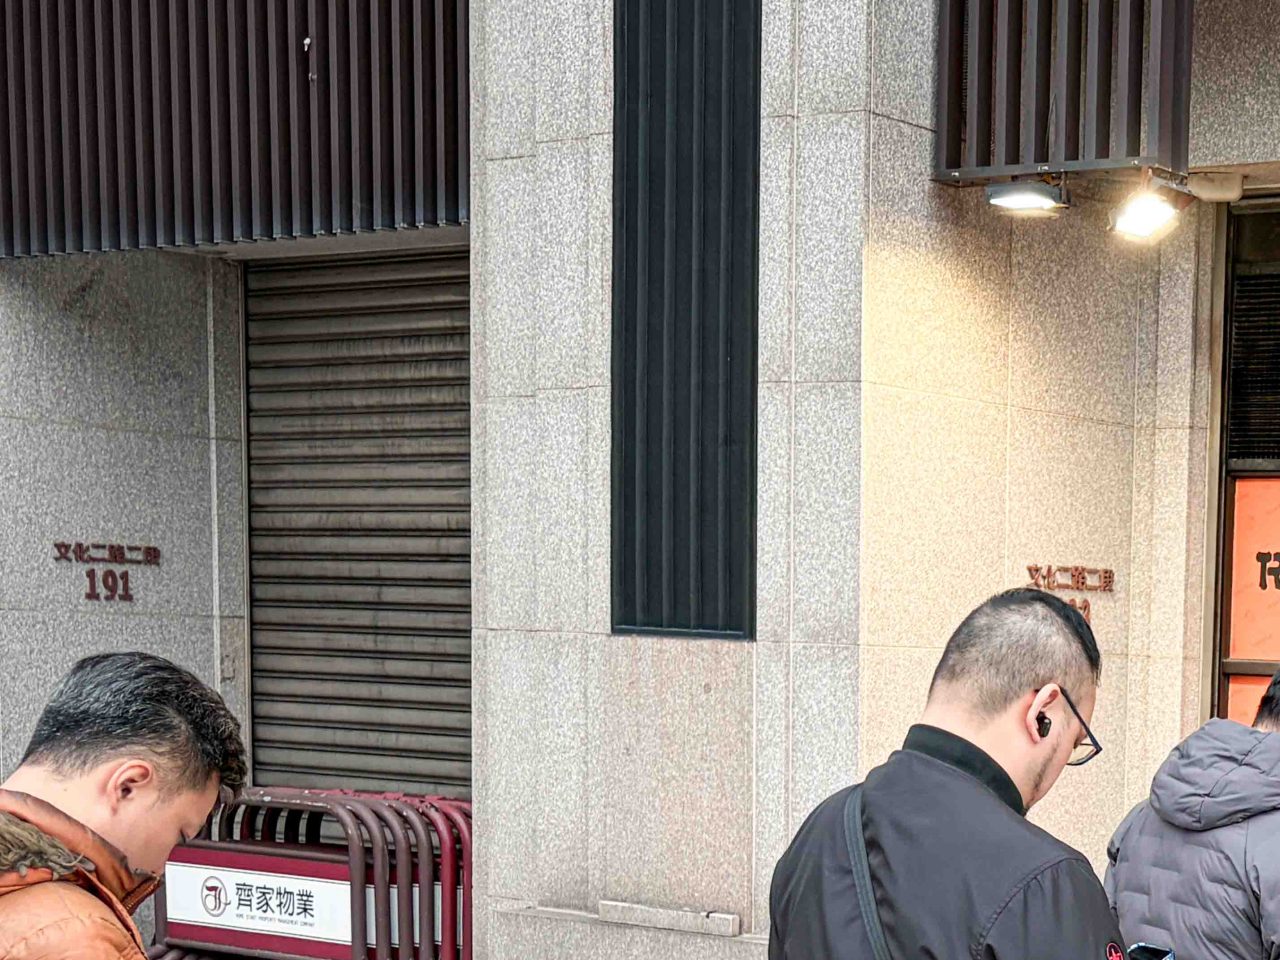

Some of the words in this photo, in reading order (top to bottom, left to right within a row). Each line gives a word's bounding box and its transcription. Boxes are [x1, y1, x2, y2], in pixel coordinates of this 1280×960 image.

[53, 541, 161, 567] 文化二路二段
[85, 568, 134, 602] 191
[235, 882, 314, 918] 齊家物業
